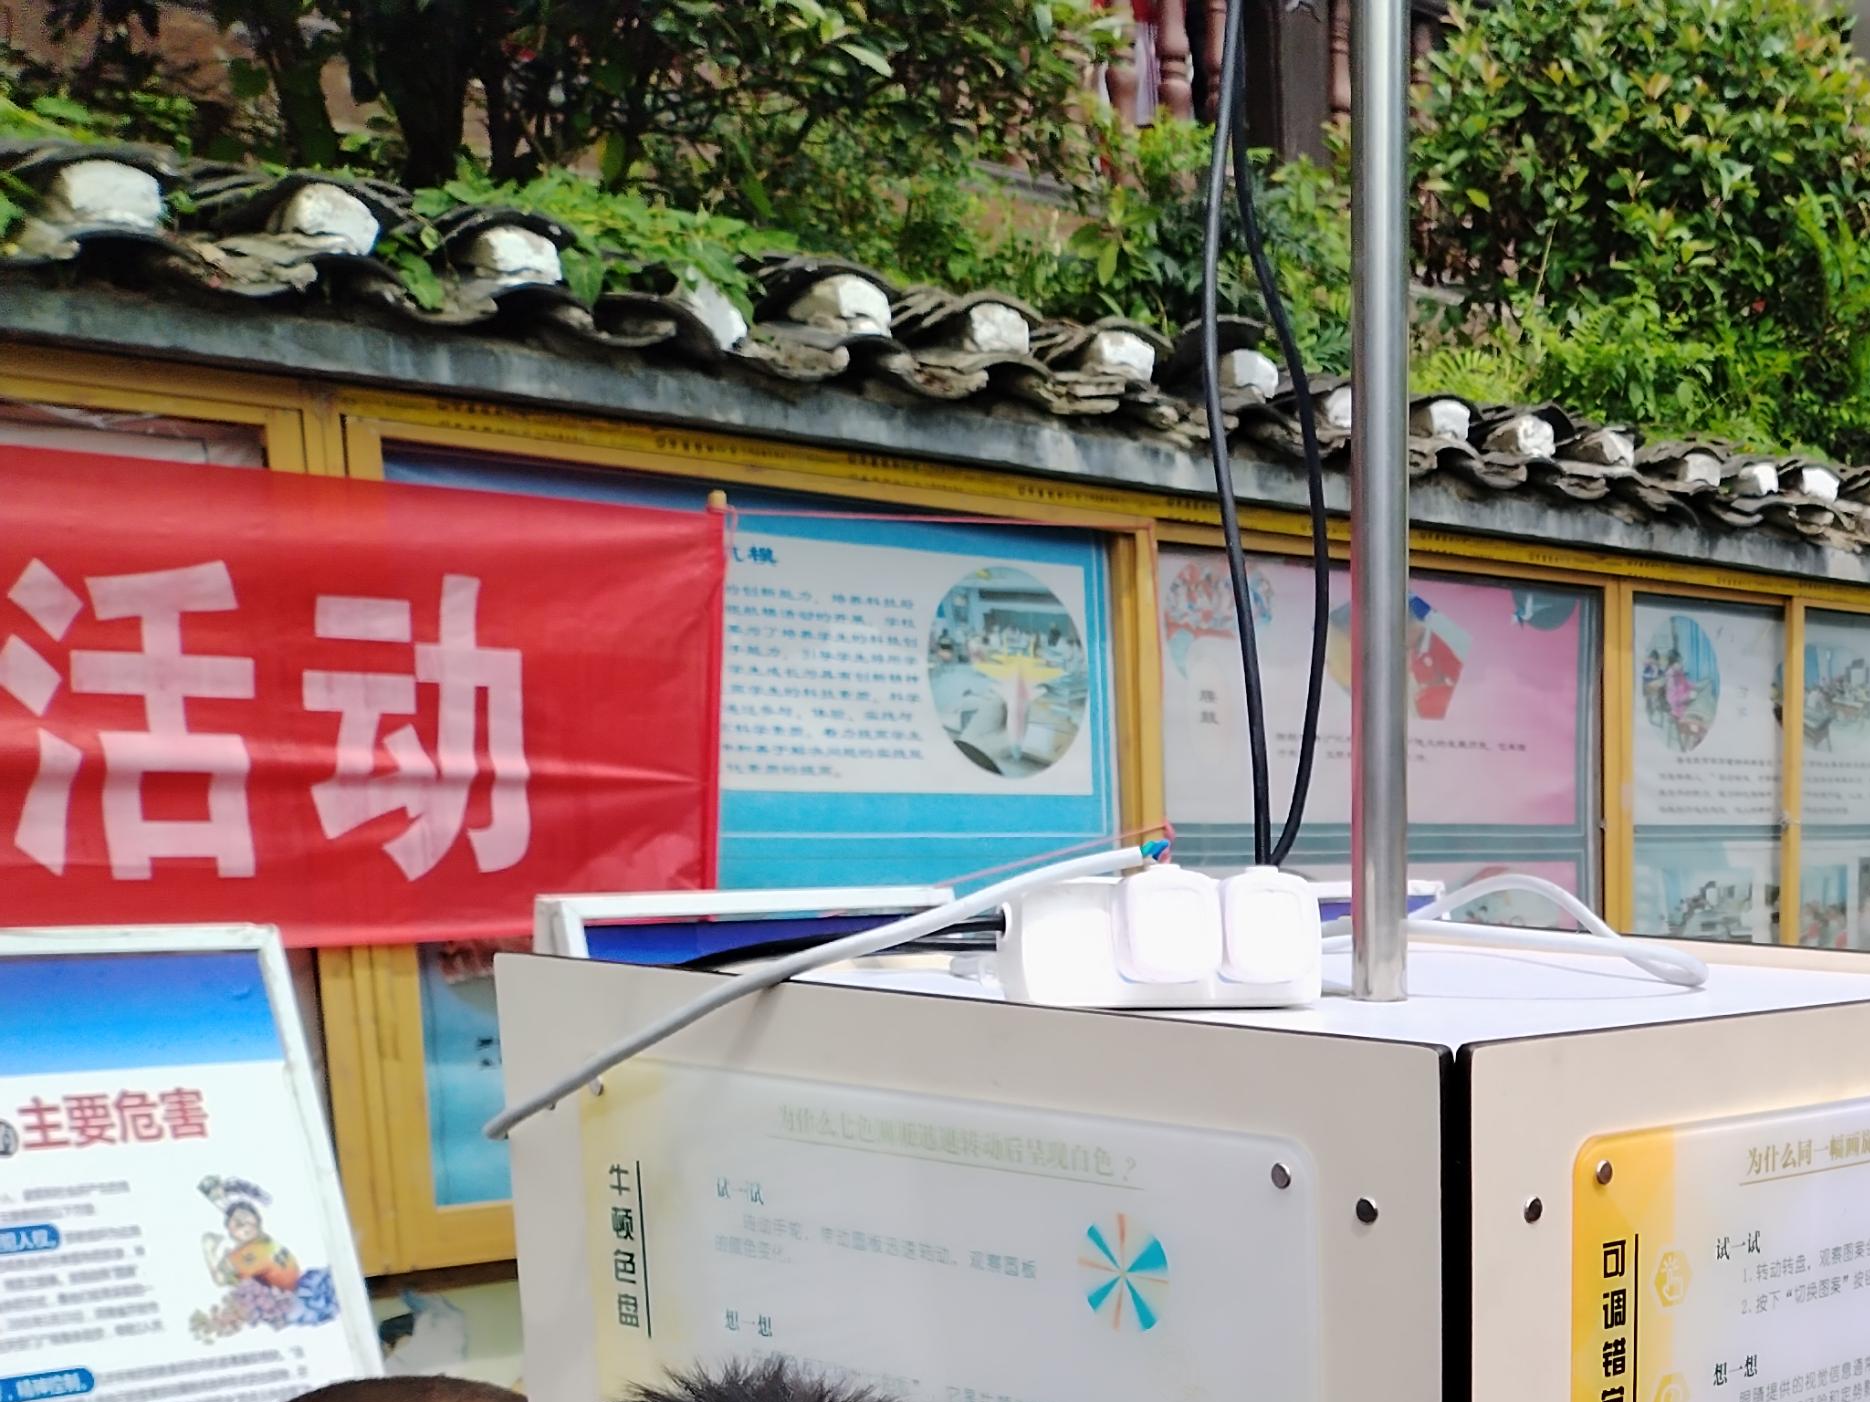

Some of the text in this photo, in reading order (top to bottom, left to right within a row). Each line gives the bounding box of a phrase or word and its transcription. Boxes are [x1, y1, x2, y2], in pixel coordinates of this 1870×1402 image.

[0, 557, 532, 882] 活动
[715, 1176, 765, 1206] 试一试
[608, 1163, 640, 1328] 牛顿色盘
[1715, 1230, 1761, 1261] 试一试
[726, 1308, 773, 1338] 想一想
[1713, 1354, 1759, 1388] 想一想
